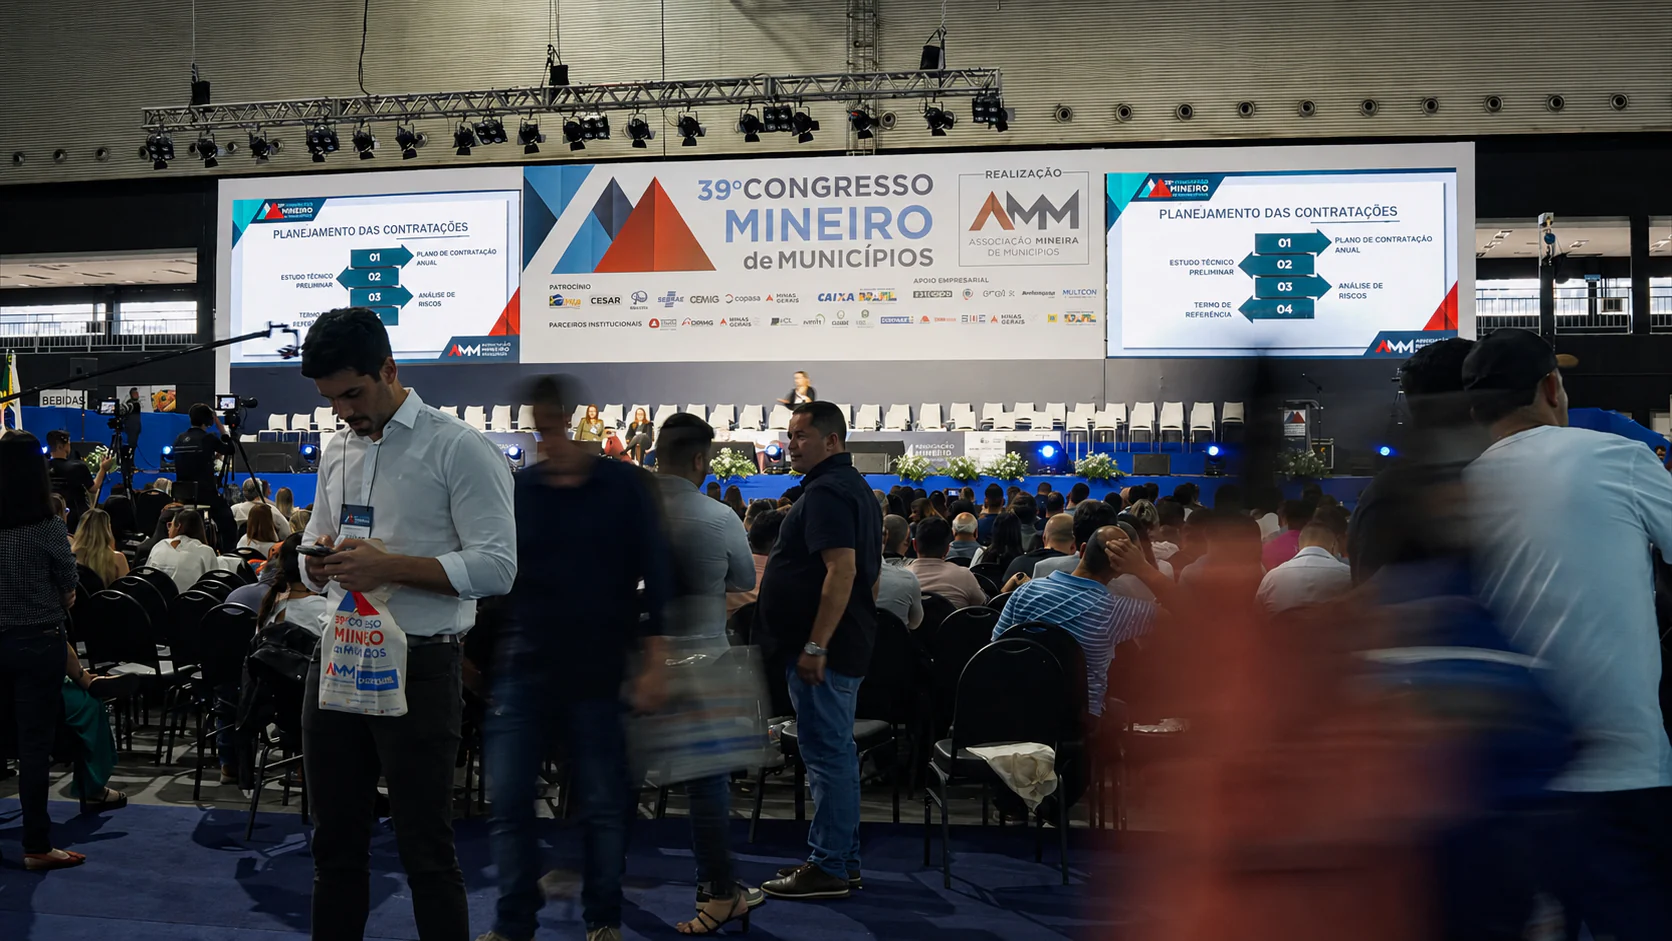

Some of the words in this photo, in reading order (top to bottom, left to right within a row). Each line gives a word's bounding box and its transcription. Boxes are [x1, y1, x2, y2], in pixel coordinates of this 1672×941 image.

[986, 167, 1062, 180] REALIZAÇÃO
[969, 189, 1079, 231] AMM
[1160, 208, 1260, 219] PLANEJAMENTO
[1265, 208, 1291, 218] DAS
[1295, 204, 1398, 219] CONTRATAÇÕES
[726, 205, 934, 243] MINEIRO
[274, 227, 356, 239] PLANEJAMENTO
[359, 226, 380, 235] DAS
[384, 221, 468, 235] CONTRATAÇÕES
[1036, 237, 1079, 245] MINEIRA
[1278, 238, 1292, 248] 01
[370, 253, 380, 262] 01
[744, 252, 773, 270] de
[779, 244, 934, 269] MUNICÍPIOS
[988, 249, 1000, 257] DE
[1202, 258, 1234, 266] TÉCNICO
[1277, 260, 1293, 269] 02
[368, 272, 381, 281] 02
[550, 283, 591, 291] PATROCÍNIO
[1277, 282, 1293, 291] 03
[368, 293, 381, 302] 03
[591, 297, 621, 305] CESAR
[690, 295, 720, 304] CEMIG
[818, 292, 855, 302] CAIXA
[1277, 304, 1293, 314] 04
[448, 344, 480, 357] AMM
[1376, 340, 1414, 354] AMM
[43, 396, 86, 406] BEBIDAS
[326, 662, 356, 679] AMM
